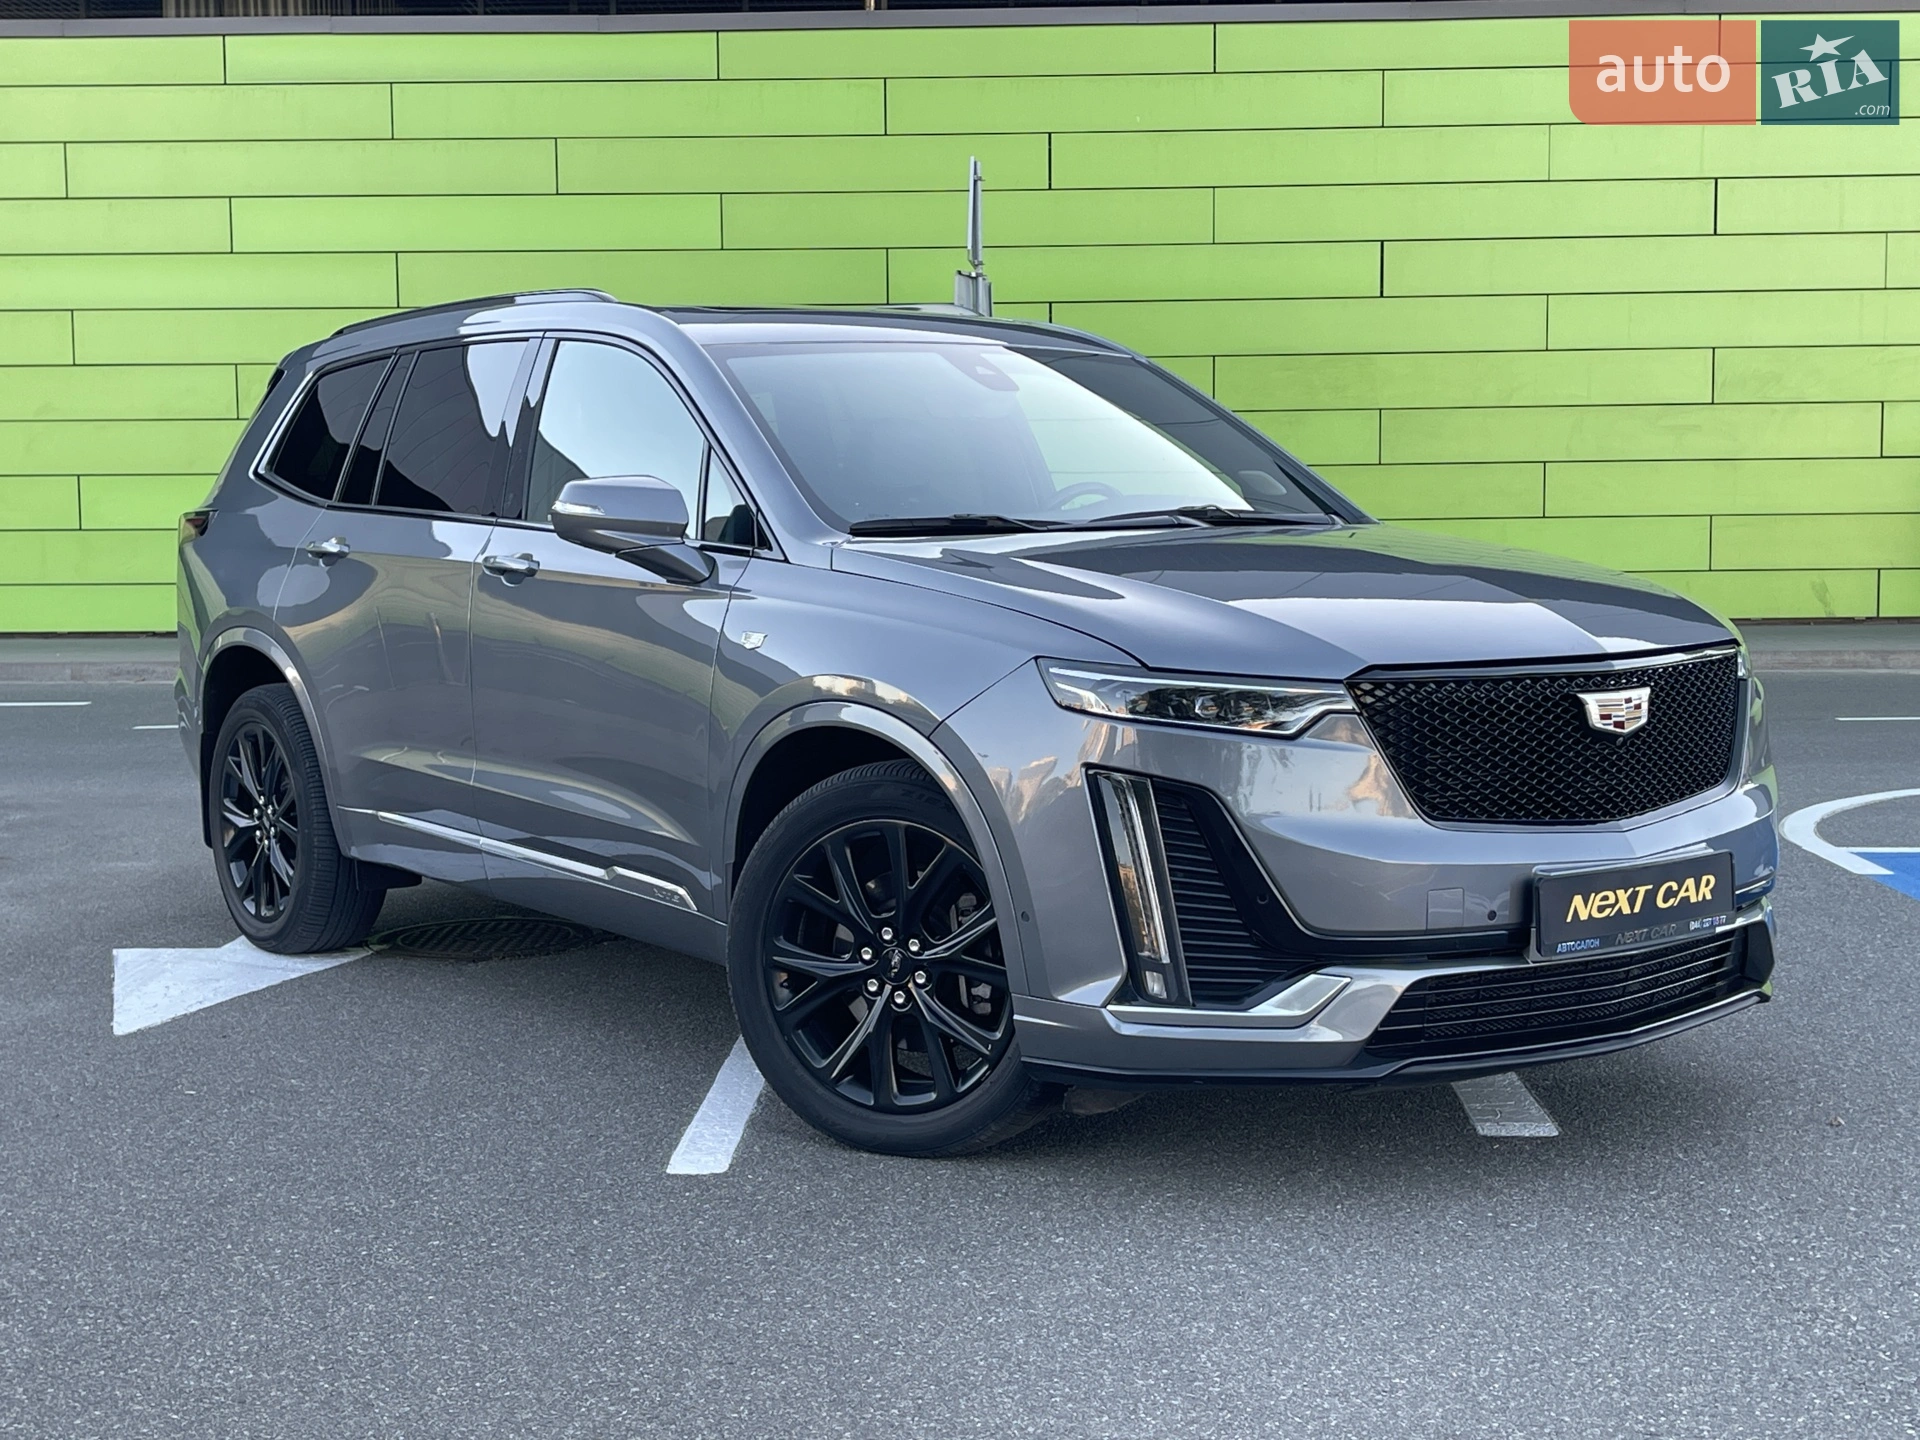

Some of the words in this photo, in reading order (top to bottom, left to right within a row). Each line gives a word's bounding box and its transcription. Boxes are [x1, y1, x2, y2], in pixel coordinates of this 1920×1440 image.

[1656, 874, 1716, 909] CAR
[1650, 923, 1677, 940] CAR
[1556, 938, 1600, 953] АВТОСАЛОН
